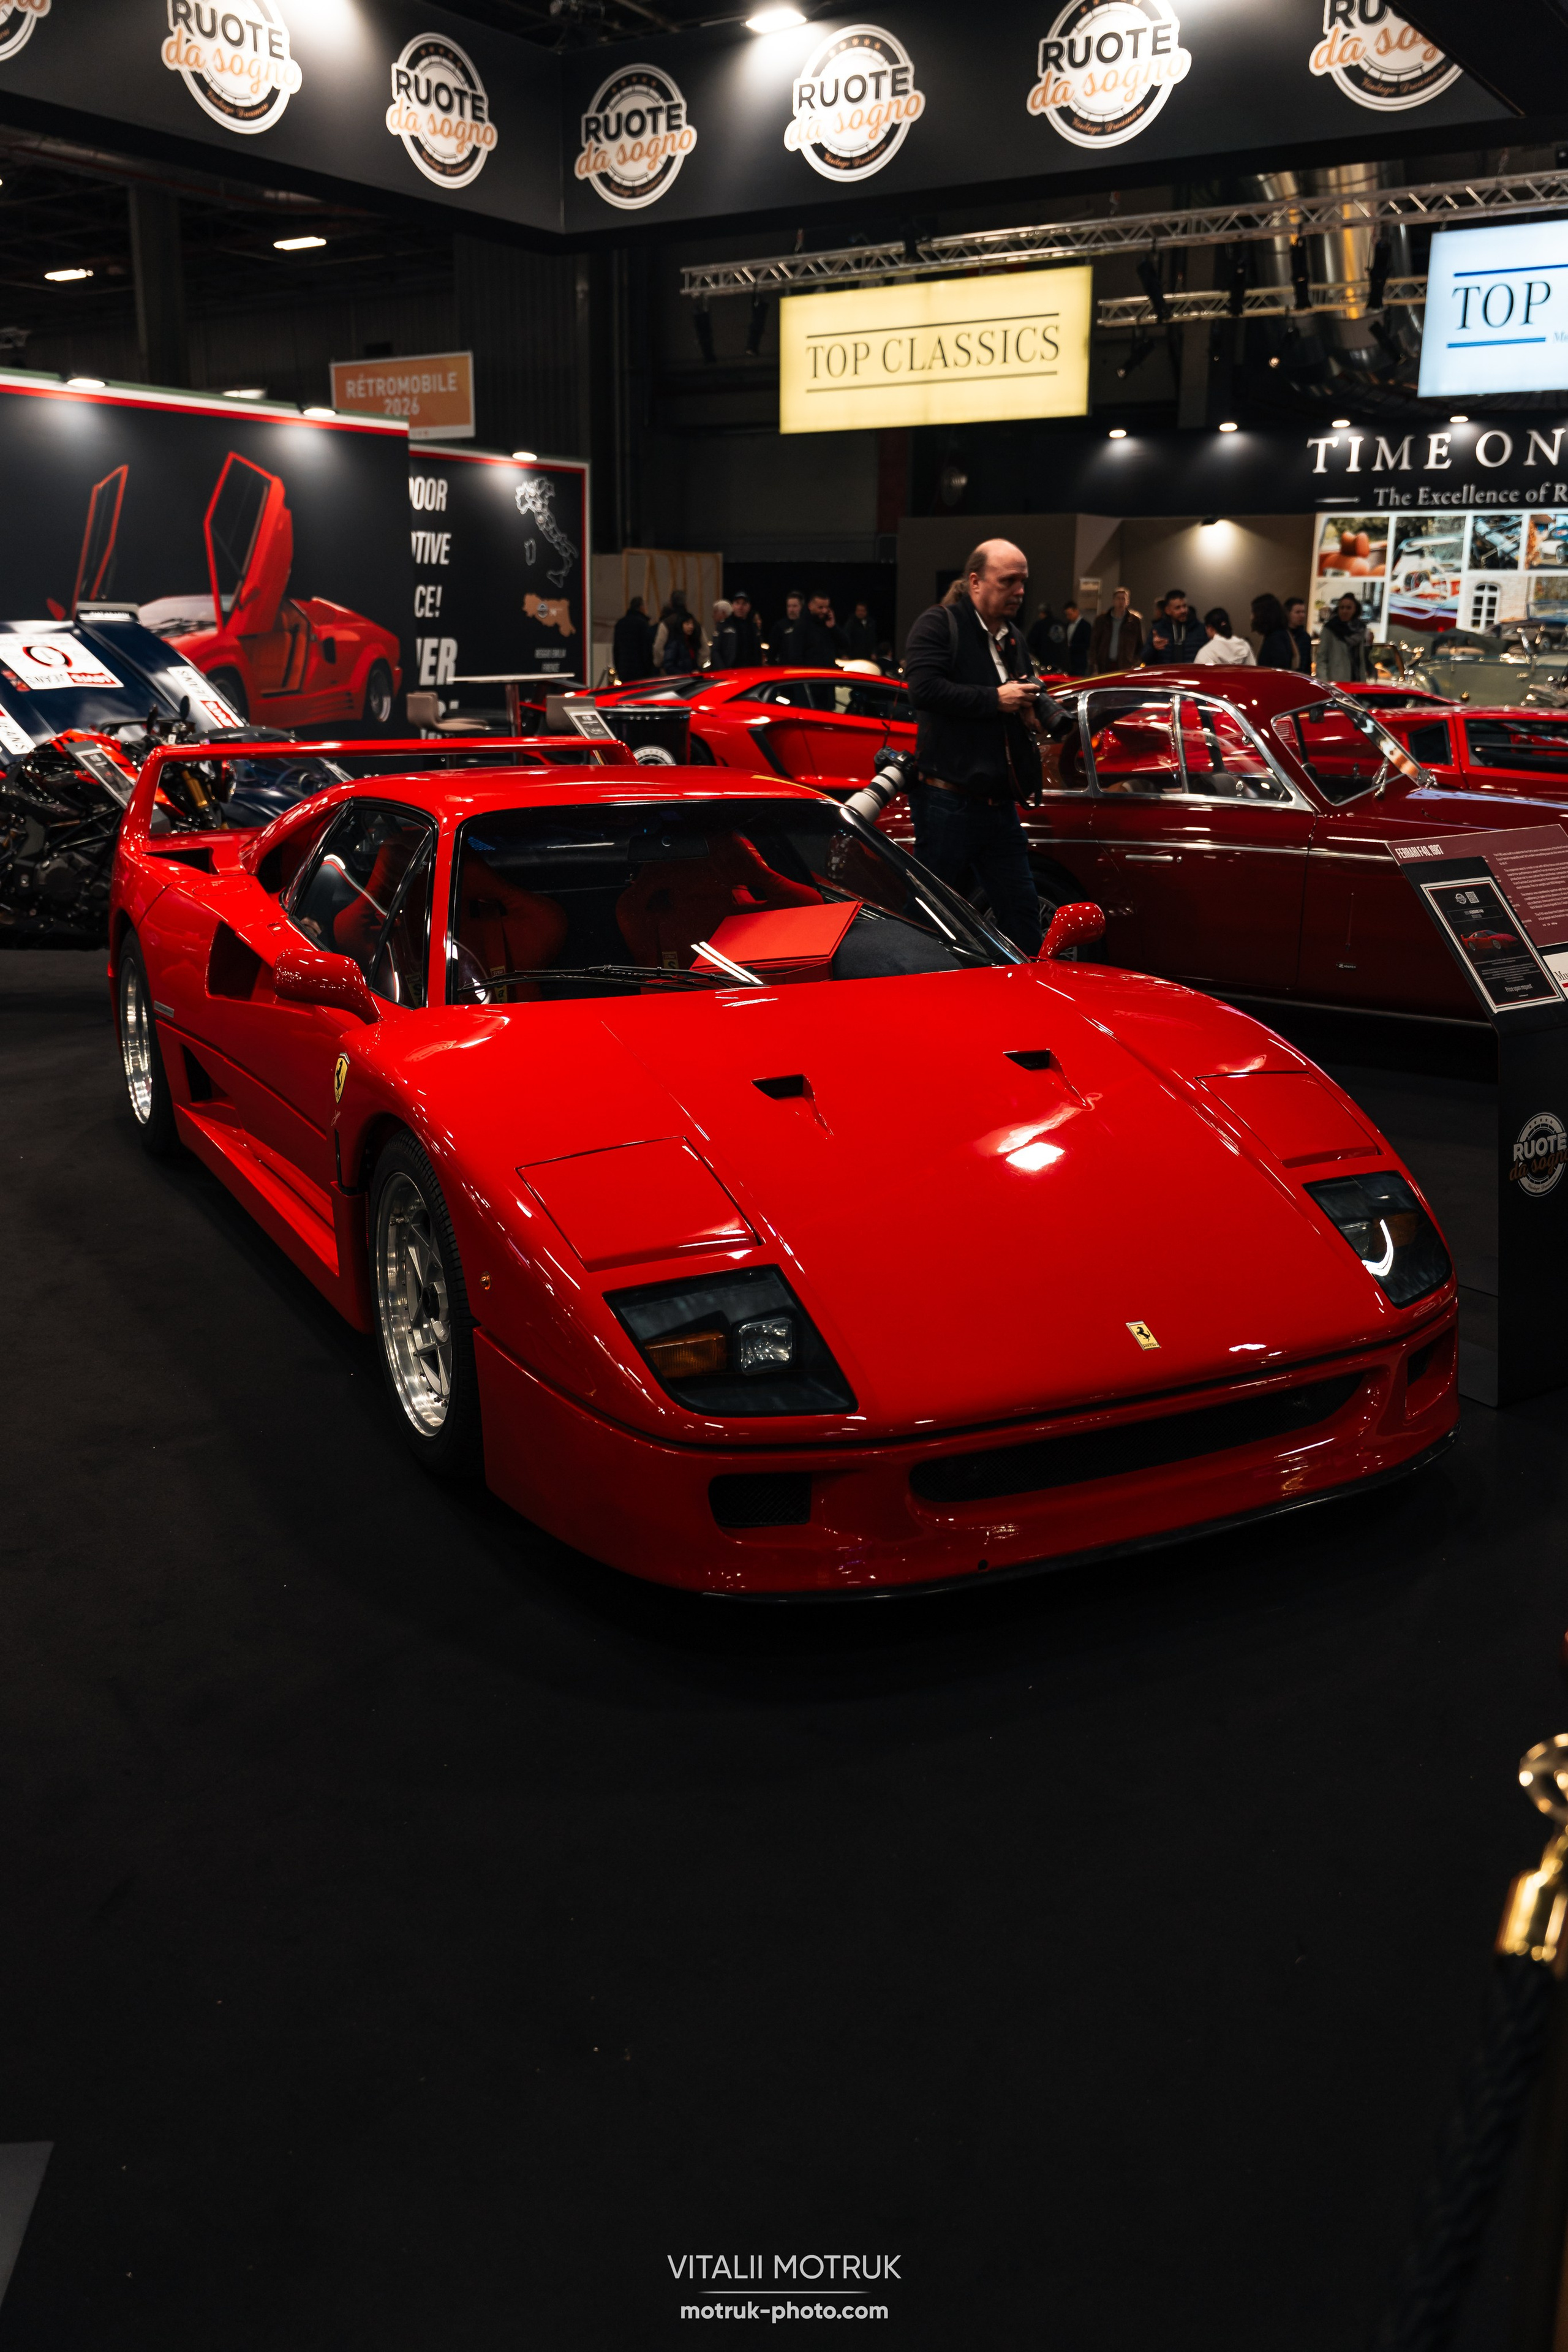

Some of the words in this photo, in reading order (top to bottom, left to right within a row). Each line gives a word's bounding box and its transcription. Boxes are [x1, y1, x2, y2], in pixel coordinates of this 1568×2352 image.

[172, 0, 284, 60] RUOTE
[1043, 23, 1172, 73] RUOTE
[1314, 27, 1366, 70] da
[165, 28, 206, 68] da
[214, 48, 296, 94] sogno
[1031, 70, 1074, 110] da
[1084, 55, 1185, 102] sogno
[396, 69, 486, 123] RUOTE
[799, 67, 910, 110] RUOTE
[390, 97, 421, 132] da
[428, 113, 494, 154] sogno
[585, 103, 682, 144] RUOTE
[789, 111, 824, 145] da
[834, 94, 922, 140] sogno
[578, 142, 611, 175] da
[616, 129, 693, 171] sogno
[1452, 281, 1551, 331] TOP
[806, 341, 870, 380] TOP
[883, 324, 1060, 374] CLASSICS
[345, 372, 458, 398] RÉTROMOBILE
[383, 397, 420, 416] 2026
[1306, 431, 1453, 473] TIME
[1373, 486, 1412, 507] The
[1417, 483, 1520, 506] Excellence
[1525, 481, 1551, 503] of
[1395, 846, 1421, 859] FERRARI
[1513, 1132, 1567, 1161] RUOTE
[1509, 1159, 1528, 1181] da
